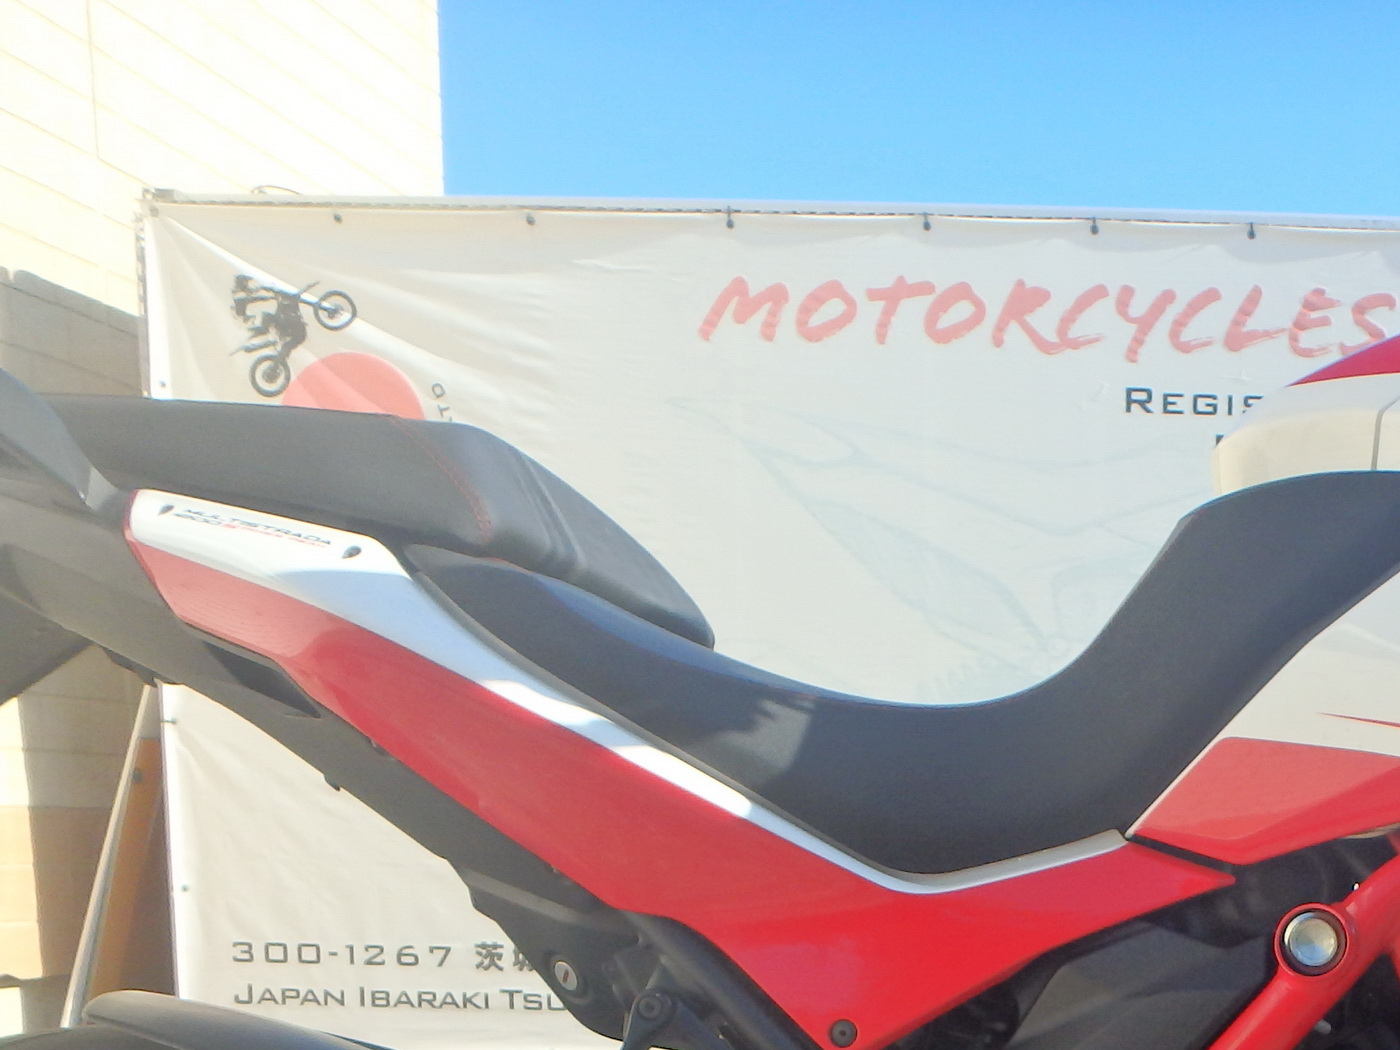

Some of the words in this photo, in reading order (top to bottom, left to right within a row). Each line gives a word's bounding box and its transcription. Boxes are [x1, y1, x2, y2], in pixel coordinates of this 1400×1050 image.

[697, 274, 1397, 362] MOTORCYCLES
[232, 941, 452, 968] 300-1267
[234, 983, 345, 1007] JAPAN
[359, 986, 490, 1010] IBARAKI
